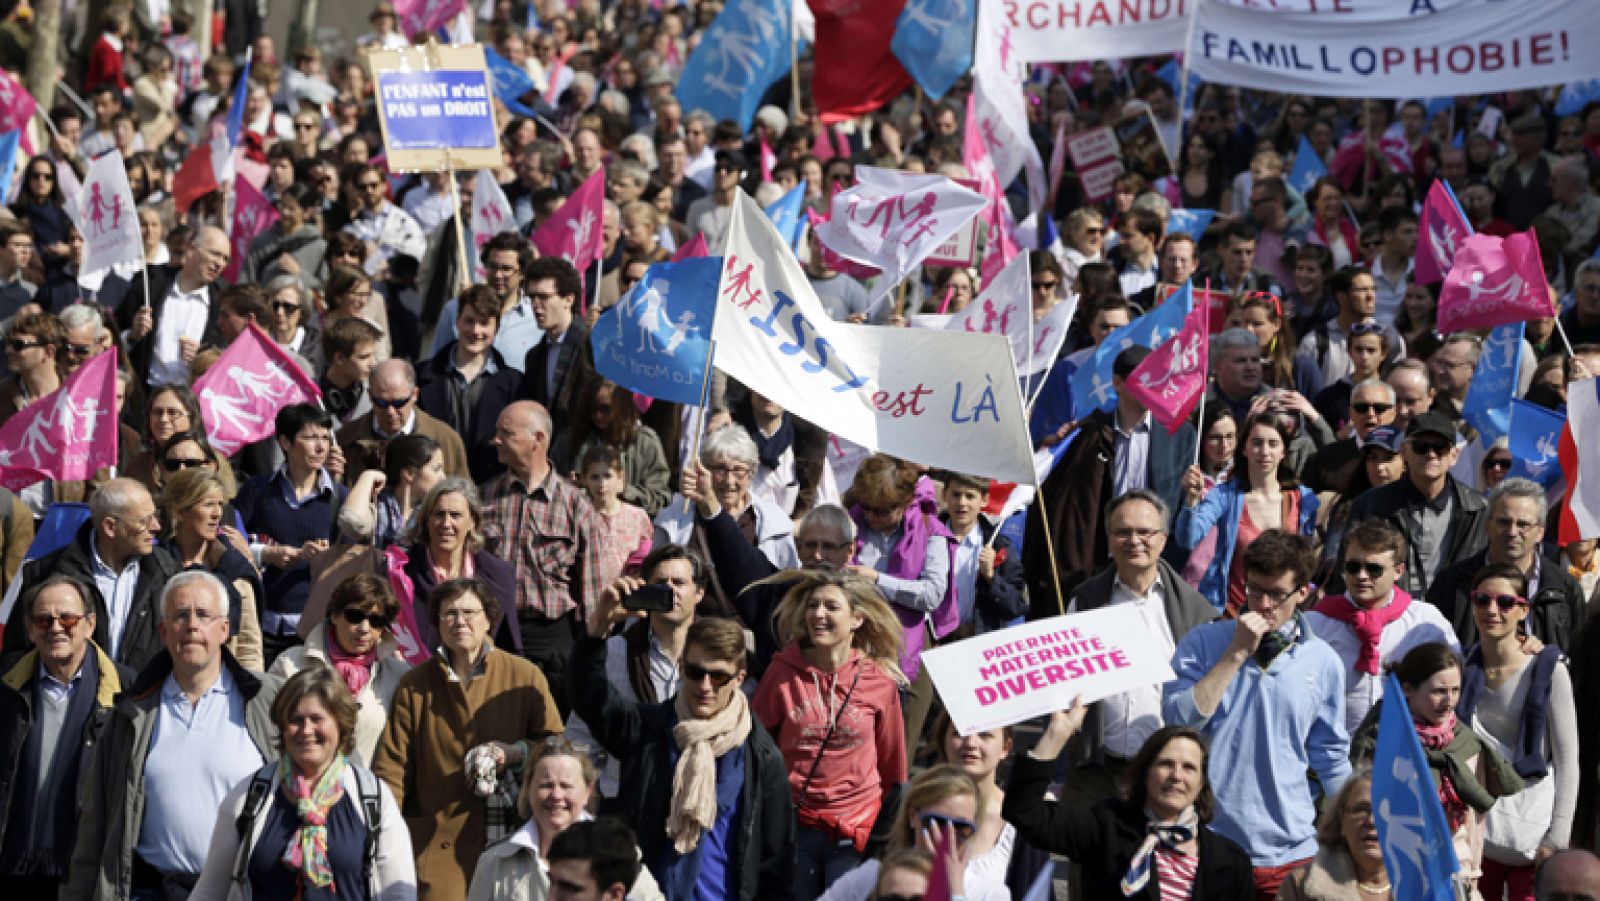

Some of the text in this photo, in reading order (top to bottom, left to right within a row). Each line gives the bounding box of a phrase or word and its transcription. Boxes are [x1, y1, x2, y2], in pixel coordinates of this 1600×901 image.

[1203, 31, 1569, 76] FAMILLOPHOBIE!
[387, 101, 488, 119] PAS un DROIT
[451, 83, 487, 99] n'est
[871, 383, 934, 418] est
[951, 373, 1000, 424] LÀ
[979, 636, 1105, 681] MATERNITÉ
[982, 627, 1084, 662] PATERNITÉ
[974, 646, 1132, 707] DIVERSITÉ
